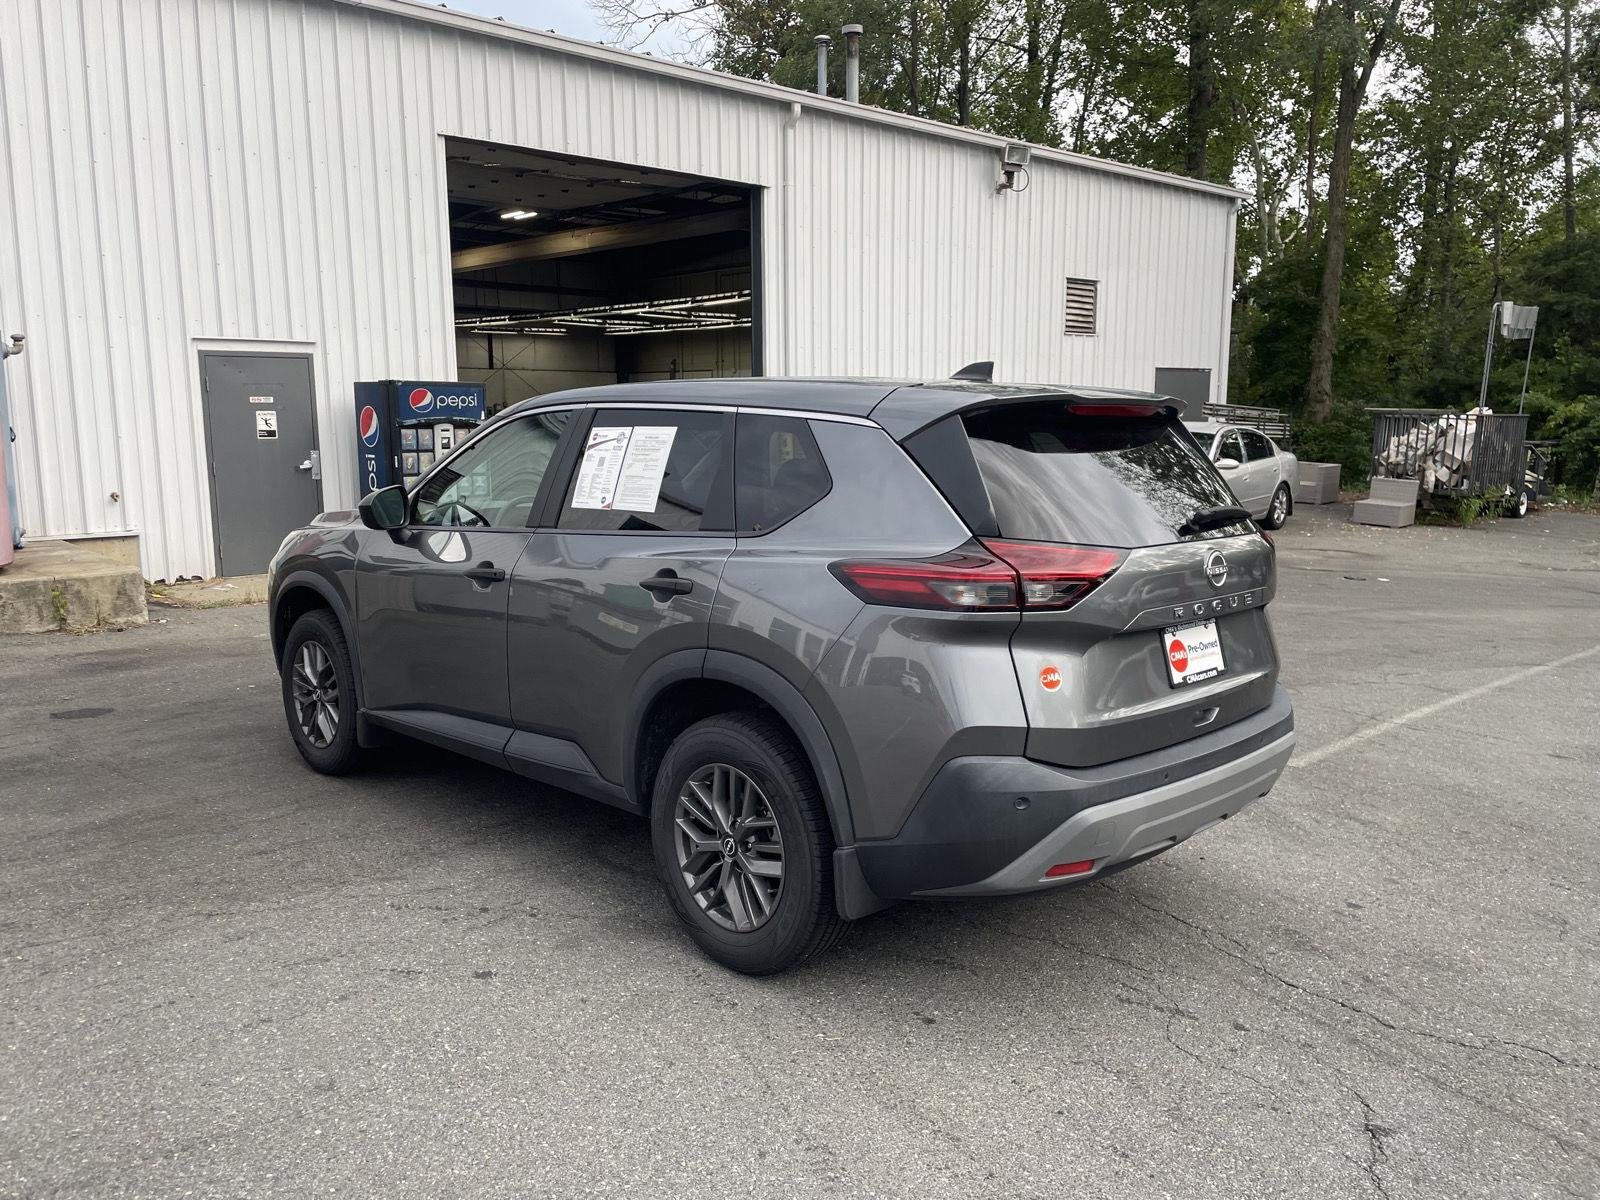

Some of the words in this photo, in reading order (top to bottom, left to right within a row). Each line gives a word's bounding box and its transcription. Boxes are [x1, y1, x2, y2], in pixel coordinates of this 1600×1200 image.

[436, 393, 478, 410] pepsi
[365, 454, 381, 491] psi
[1174, 593, 1253, 618] ROGUE
[1187, 639, 1218, 653] Pre-Owned
[1041, 673, 1062, 682] CMA
[1186, 669, 1218, 683] CMAcars.com
